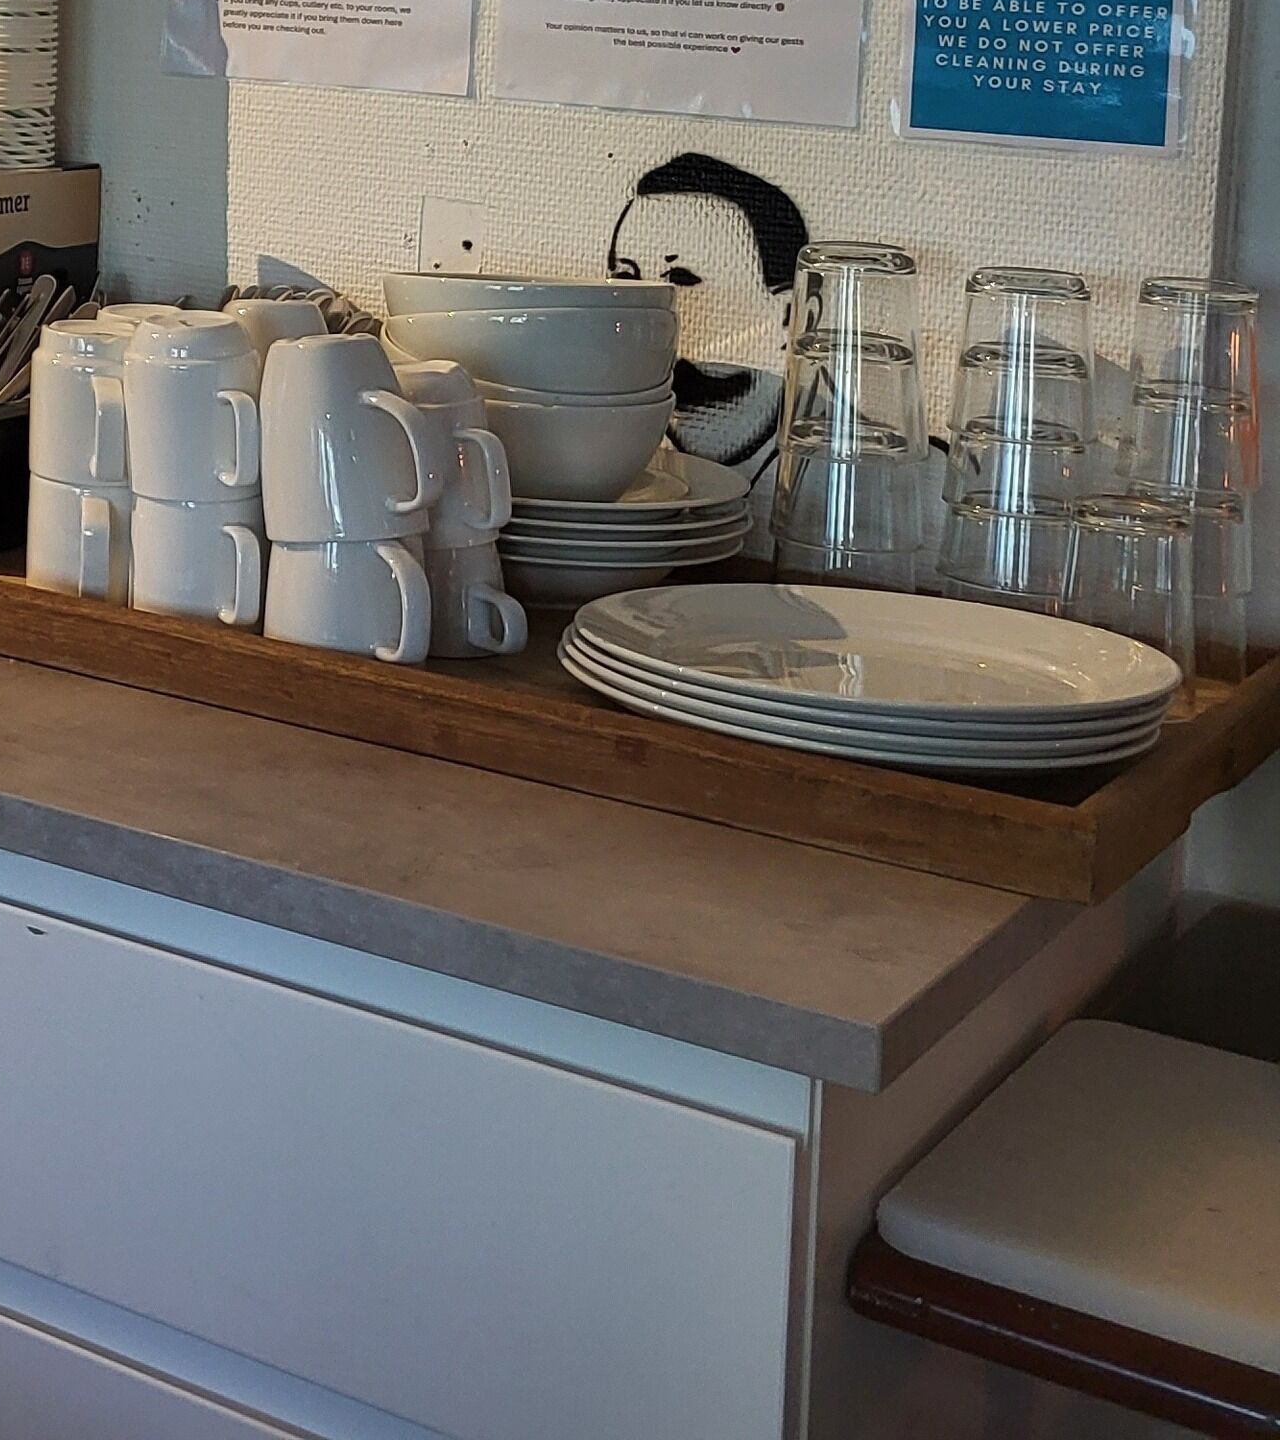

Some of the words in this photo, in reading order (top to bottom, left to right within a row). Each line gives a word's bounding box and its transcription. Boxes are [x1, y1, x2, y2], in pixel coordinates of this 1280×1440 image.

[1056, 1, 1086, 16] TO
[1097, 3, 1169, 20] OFFER
[923, 14, 968, 30] YOU
[978, 17, 991, 30] A
[1002, 18, 1077, 36] LOWER
[1089, 22, 1156, 40] PRICE
[938, 34, 968, 49] WE
[978, 36, 1007, 51] DO
[1019, 38, 1064, 54] NOT
[1074, 41, 1145, 59] OFFER
[935, 53, 1048, 73] CLEANING
[1058, 60, 1146, 78] DURING
[972, 74, 1033, 92] YOUR
[1042, 79, 1103, 96] STAY
